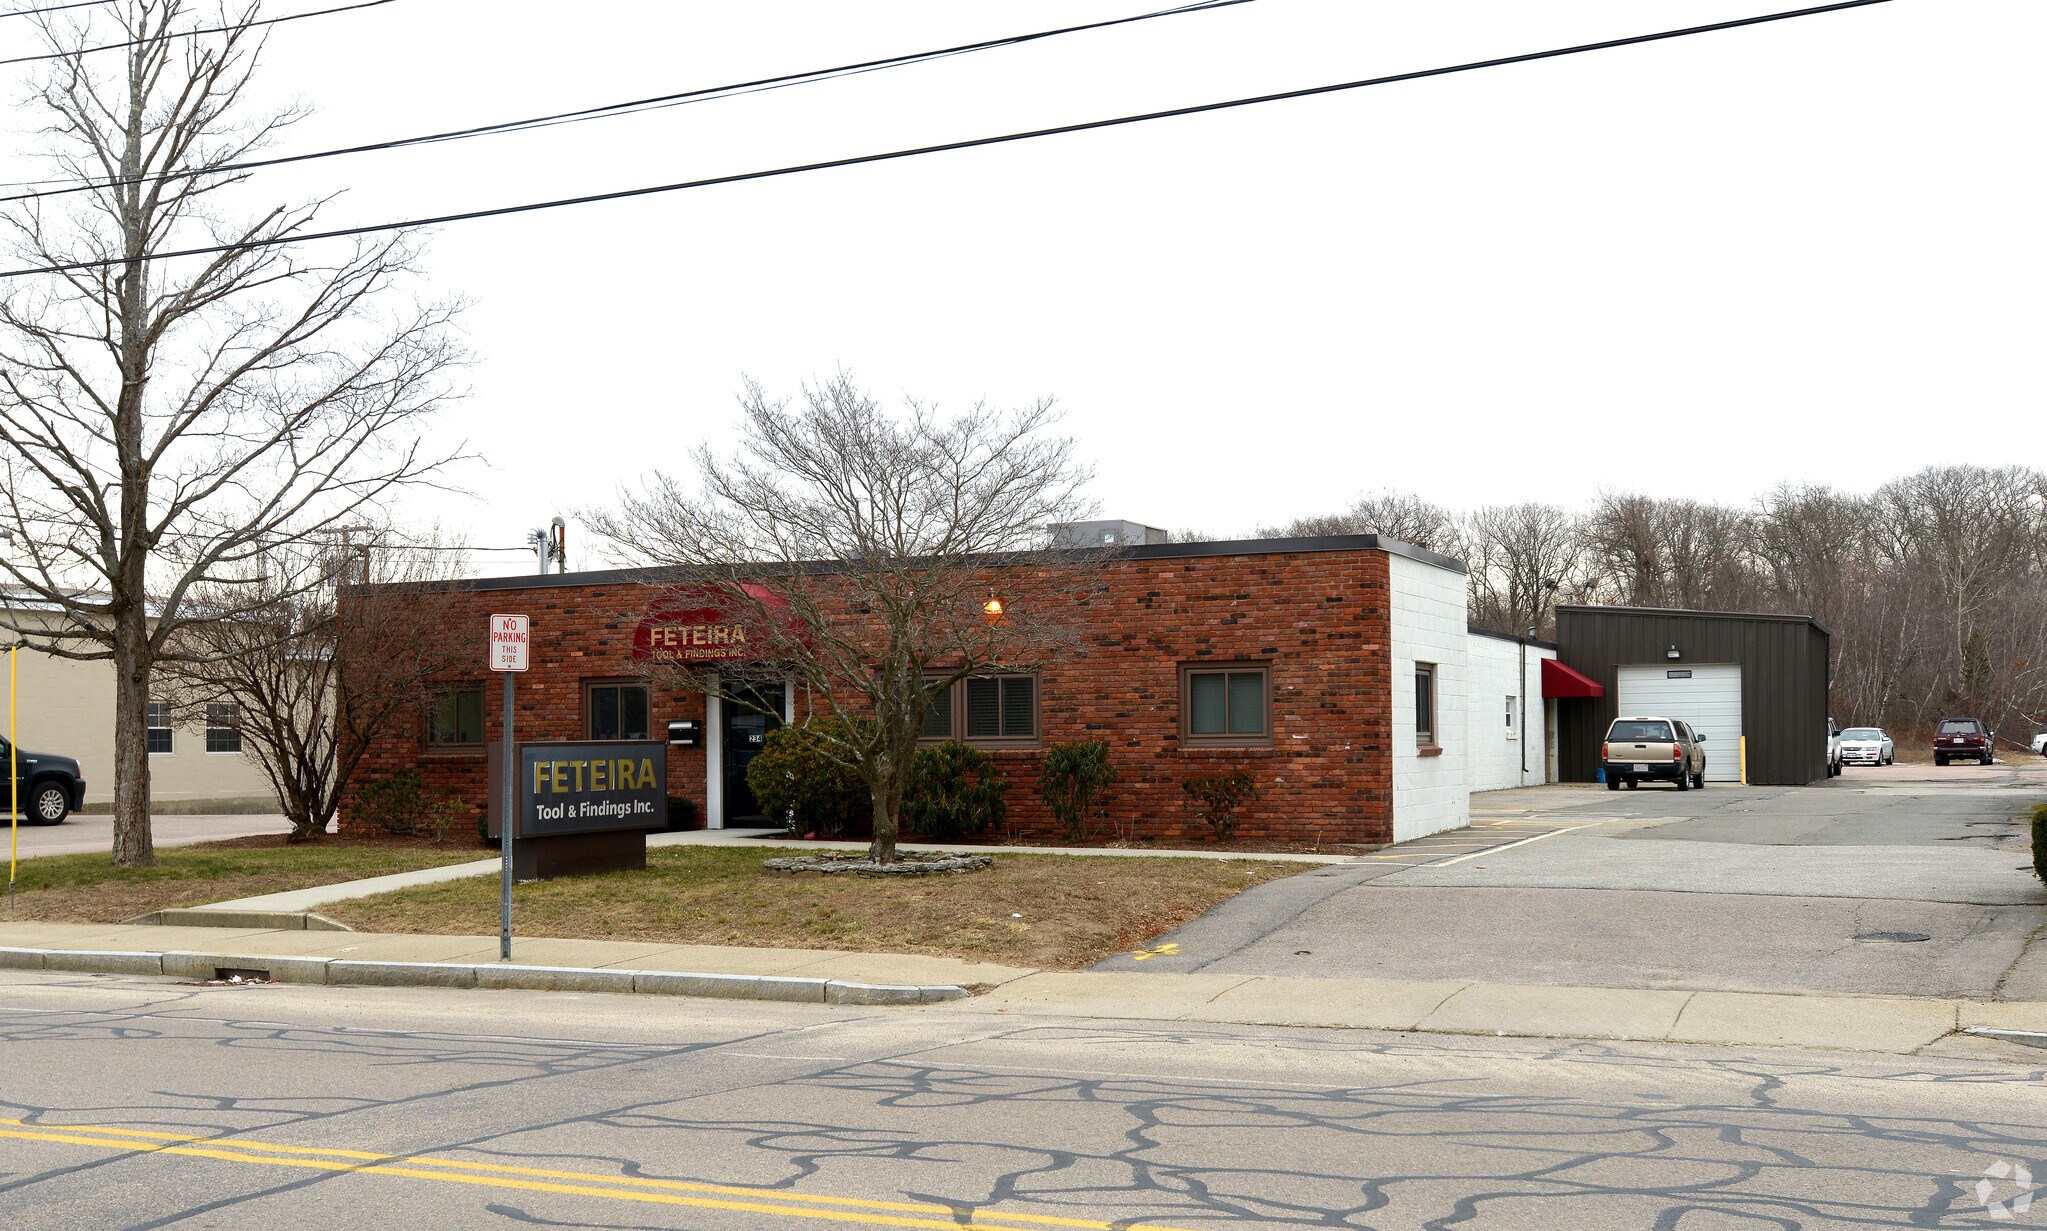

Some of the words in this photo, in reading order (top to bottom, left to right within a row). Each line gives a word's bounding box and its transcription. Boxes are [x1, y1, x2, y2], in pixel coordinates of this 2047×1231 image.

[502, 620, 517, 631] NO
[493, 632, 526, 643] PARKING
[650, 624, 746, 646] FETEIRA
[502, 645, 517, 654] THIS
[652, 650, 674, 660] TOOL
[685, 648, 726, 659] FINDINGS
[501, 655, 516, 663] SIDE
[534, 758, 657, 794] FETEIRA
[537, 803, 564, 820] Tool
[568, 805, 577, 818] &
[580, 800, 631, 818] Findings
[634, 800, 654, 814] Inc.
